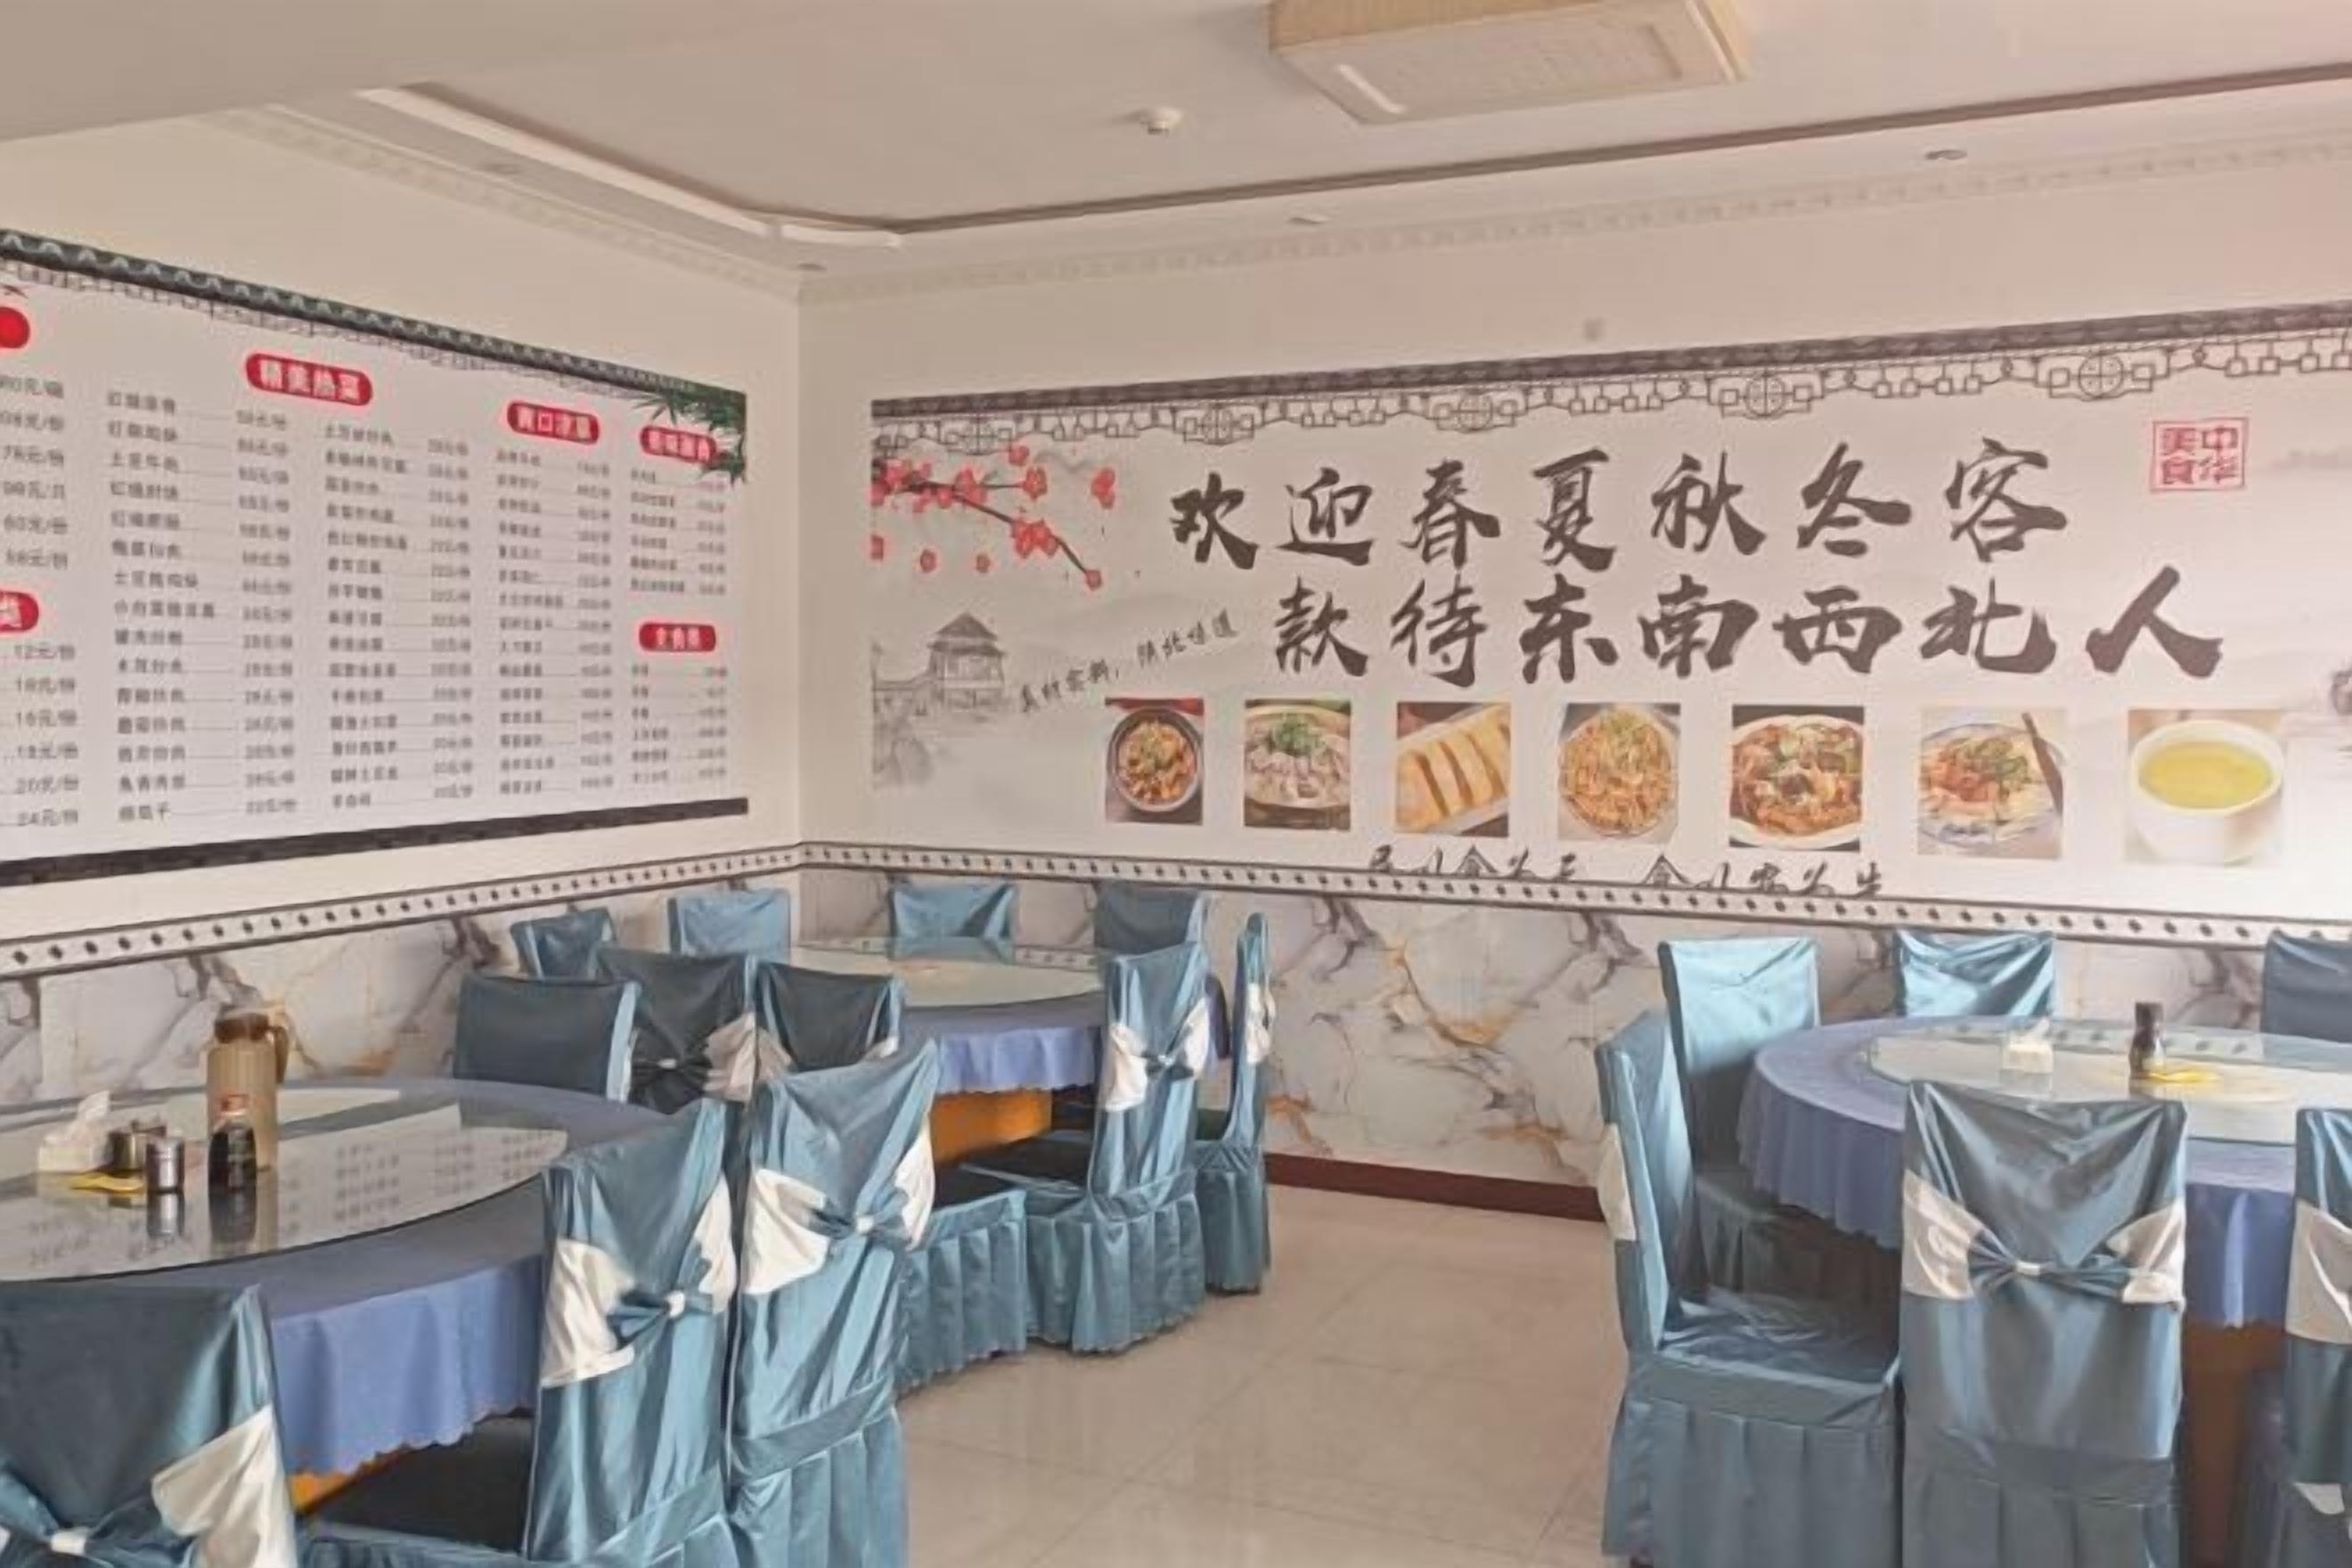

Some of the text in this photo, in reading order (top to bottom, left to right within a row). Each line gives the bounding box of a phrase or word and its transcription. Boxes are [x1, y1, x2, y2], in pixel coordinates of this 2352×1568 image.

[1169, 436, 2068, 572] 欢迎春夏秋冬客
[1275, 564, 2224, 689] 款待东南西北人
